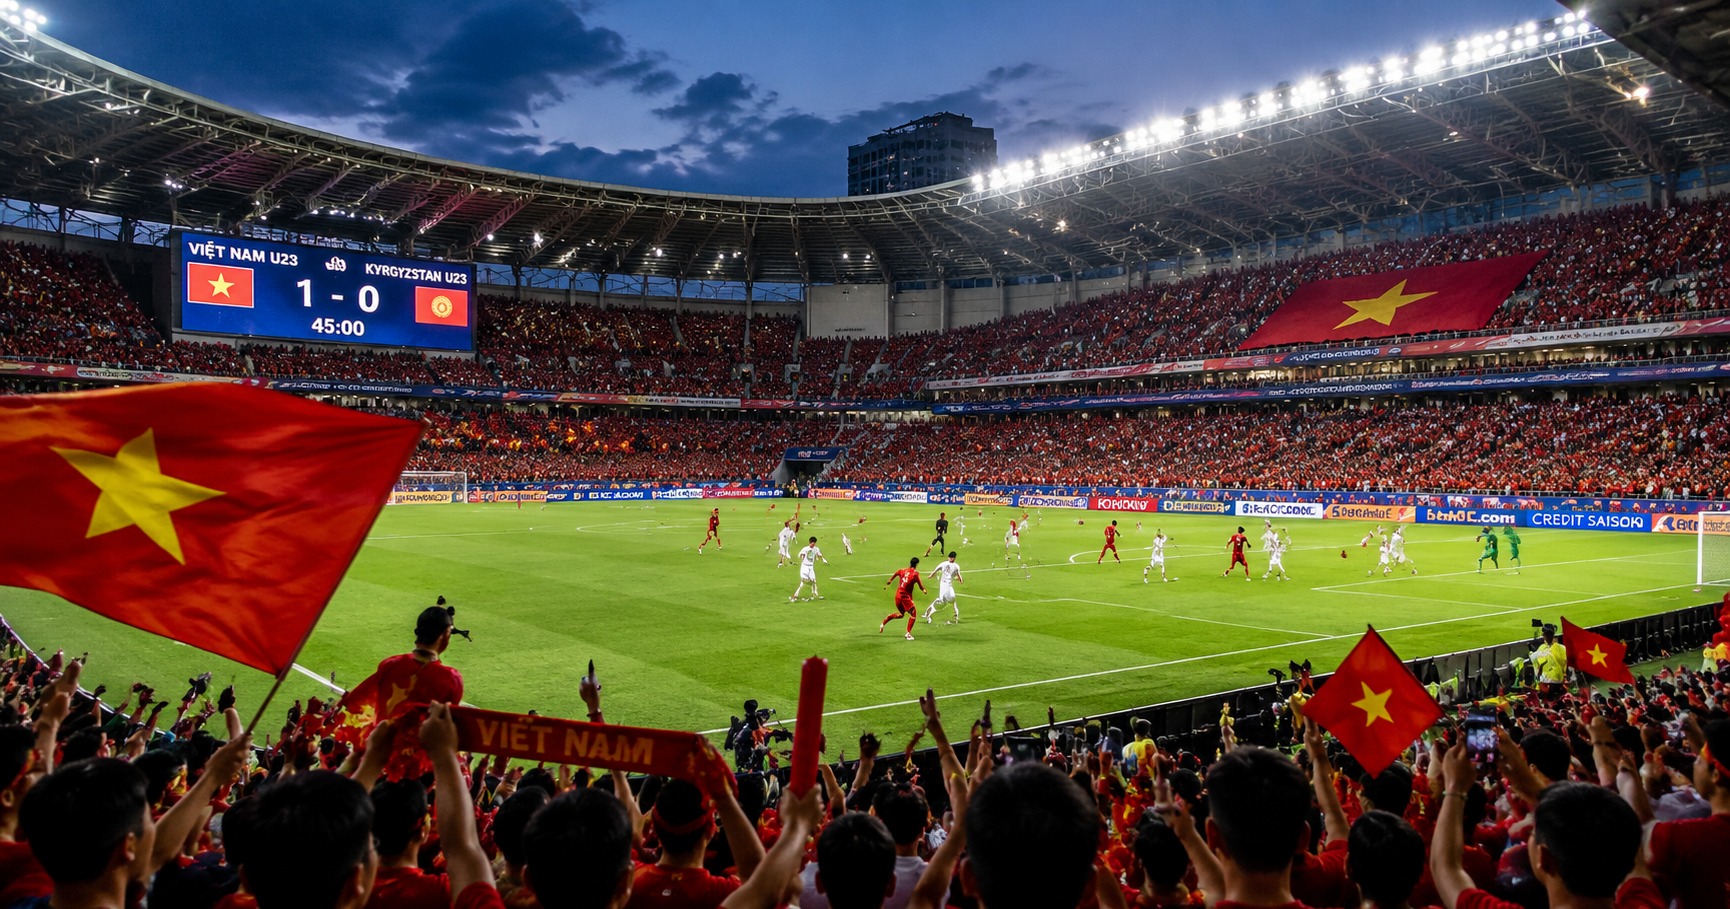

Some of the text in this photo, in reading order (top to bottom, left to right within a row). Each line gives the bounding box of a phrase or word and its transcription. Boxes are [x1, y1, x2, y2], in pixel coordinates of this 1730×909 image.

[188, 241, 298, 266] VIỆT NAM U23
[365, 263, 467, 285] KYRGYZSTAN U23
[297, 279, 312, 307] 1
[358, 285, 380, 313] 0
[311, 318, 365, 337] 45:00
[1532, 513, 1584, 526] CREDIT
[564, 728, 654, 765] NAM
